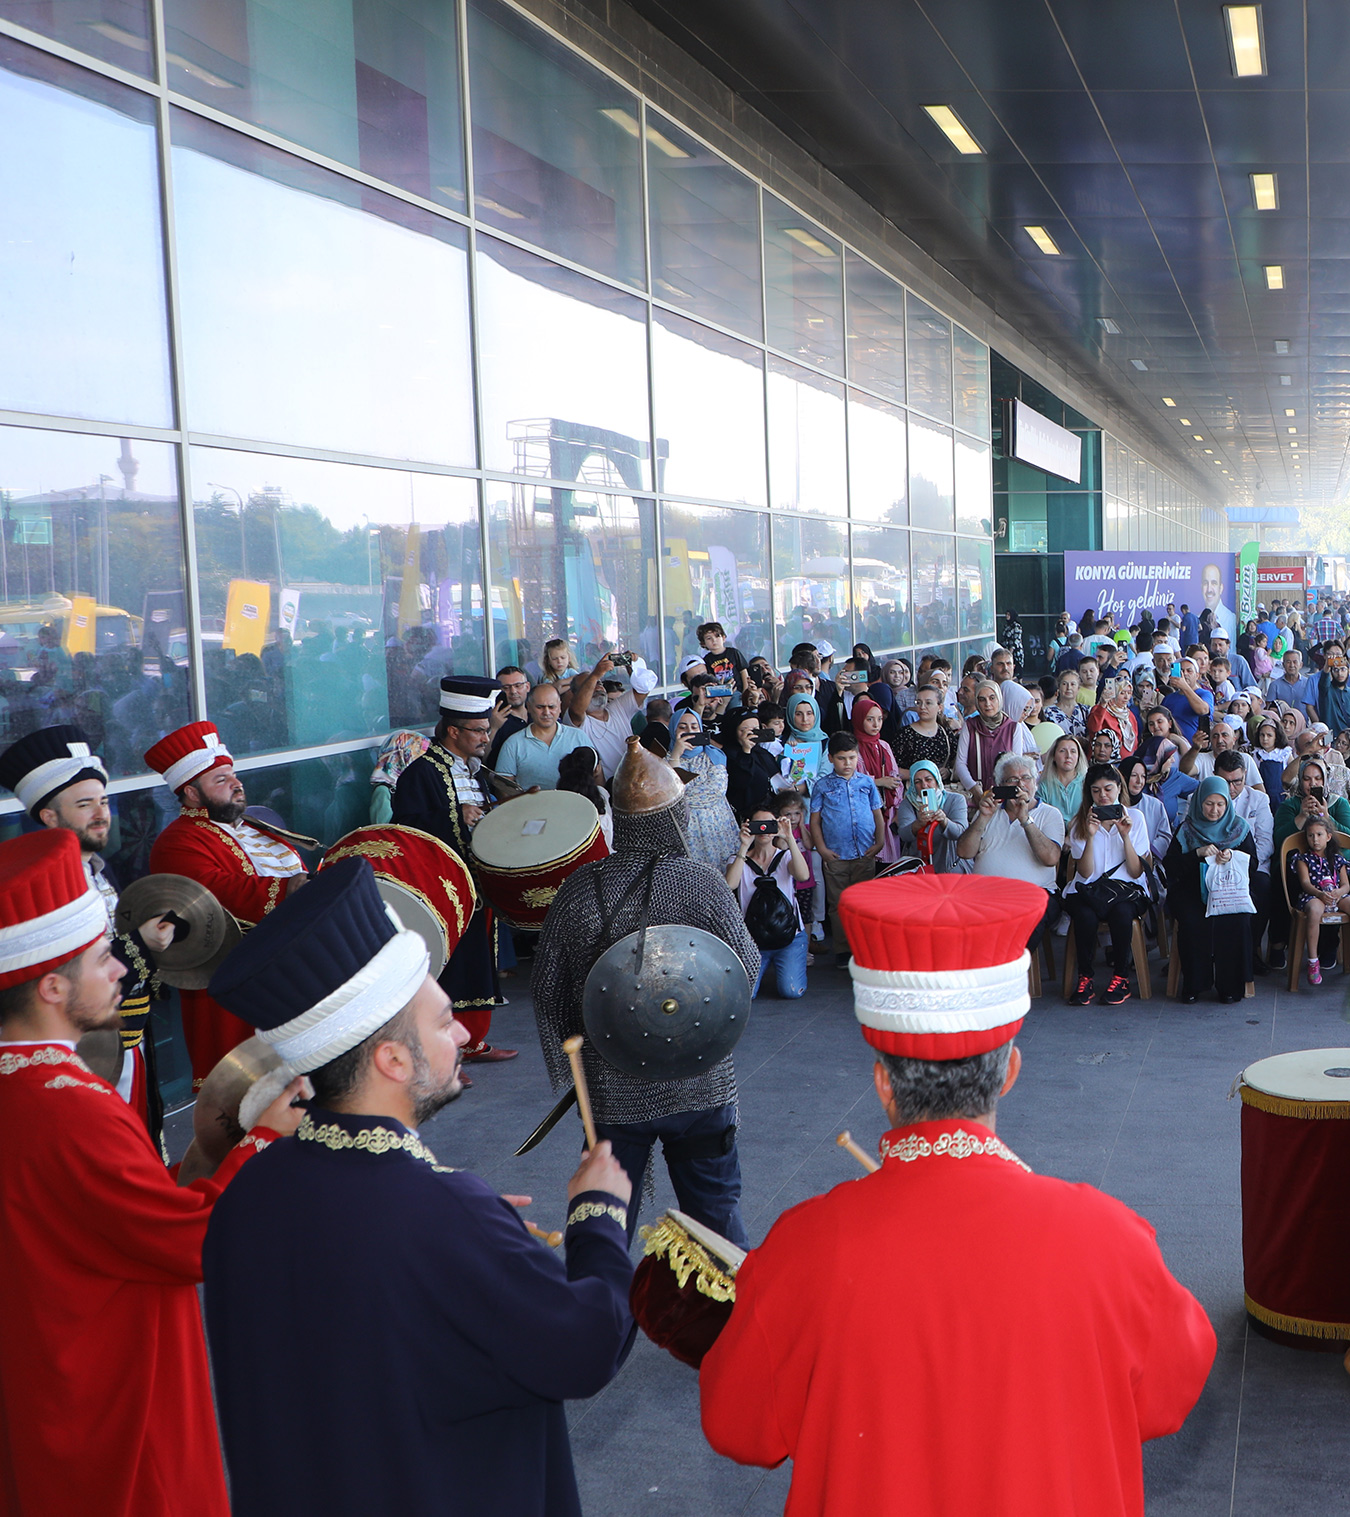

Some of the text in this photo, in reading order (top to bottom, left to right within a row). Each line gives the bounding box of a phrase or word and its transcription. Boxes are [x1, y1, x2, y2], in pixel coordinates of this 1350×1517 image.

[1075, 561, 1192, 580] KONYA GÜNLERİMİZE
[1097, 580, 1175, 627] Hoş geldiniz
